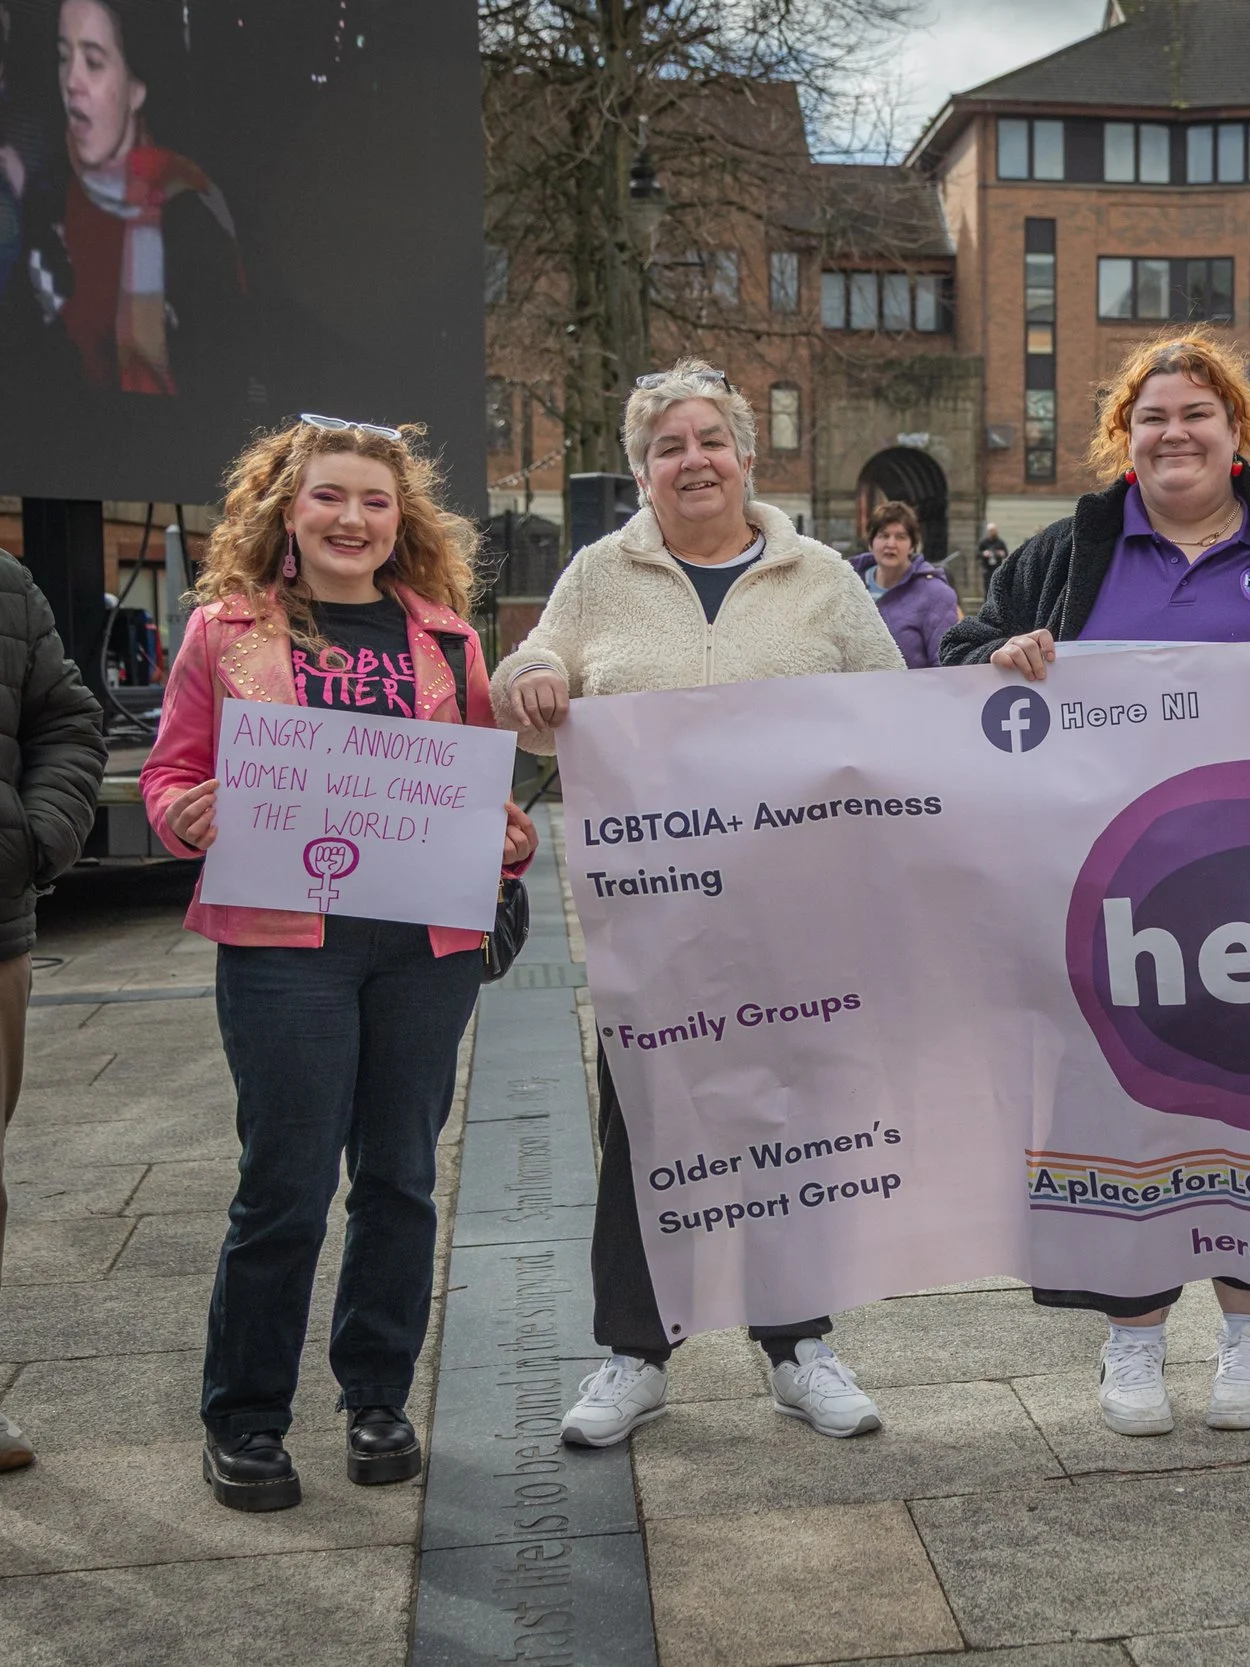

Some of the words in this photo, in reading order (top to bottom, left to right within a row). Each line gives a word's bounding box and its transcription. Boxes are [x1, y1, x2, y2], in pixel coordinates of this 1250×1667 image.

[292, 646, 415, 681] ROBLE
[1060, 699, 1147, 730] Here
[1162, 691, 1199, 720] NI
[343, 726, 458, 767] ANNOYING
[225, 759, 307, 791] WOMEN
[327, 772, 377, 797] WILL
[387, 777, 467, 808] CHANGE
[253, 802, 302, 831] THE
[324, 808, 429, 843] WORLD!
[584, 808, 743, 847] LGBTQIA+
[753, 795, 942, 831] Awareness
[586, 865, 723, 898] Training
[617, 1011, 726, 1051] Family
[736, 993, 861, 1027] Groups
[649, 1154, 742, 1191] Older
[749, 1120, 902, 1169] Women's
[658, 1193, 790, 1234] Support
[799, 1172, 902, 1208] Group
[1035, 1168, 1059, 1194] A
[1068, 1170, 1161, 1204] place
[1171, 1168, 1222, 1197] for
[497, 1321, 560, 1352] the
[499, 1354, 560, 1376] in
[494, 1378, 563, 1440] found
[493, 1444, 567, 1478] be
[500, 1482, 568, 1509] to
[495, 1514, 569, 1538] is
[492, 1543, 573, 1595] life
